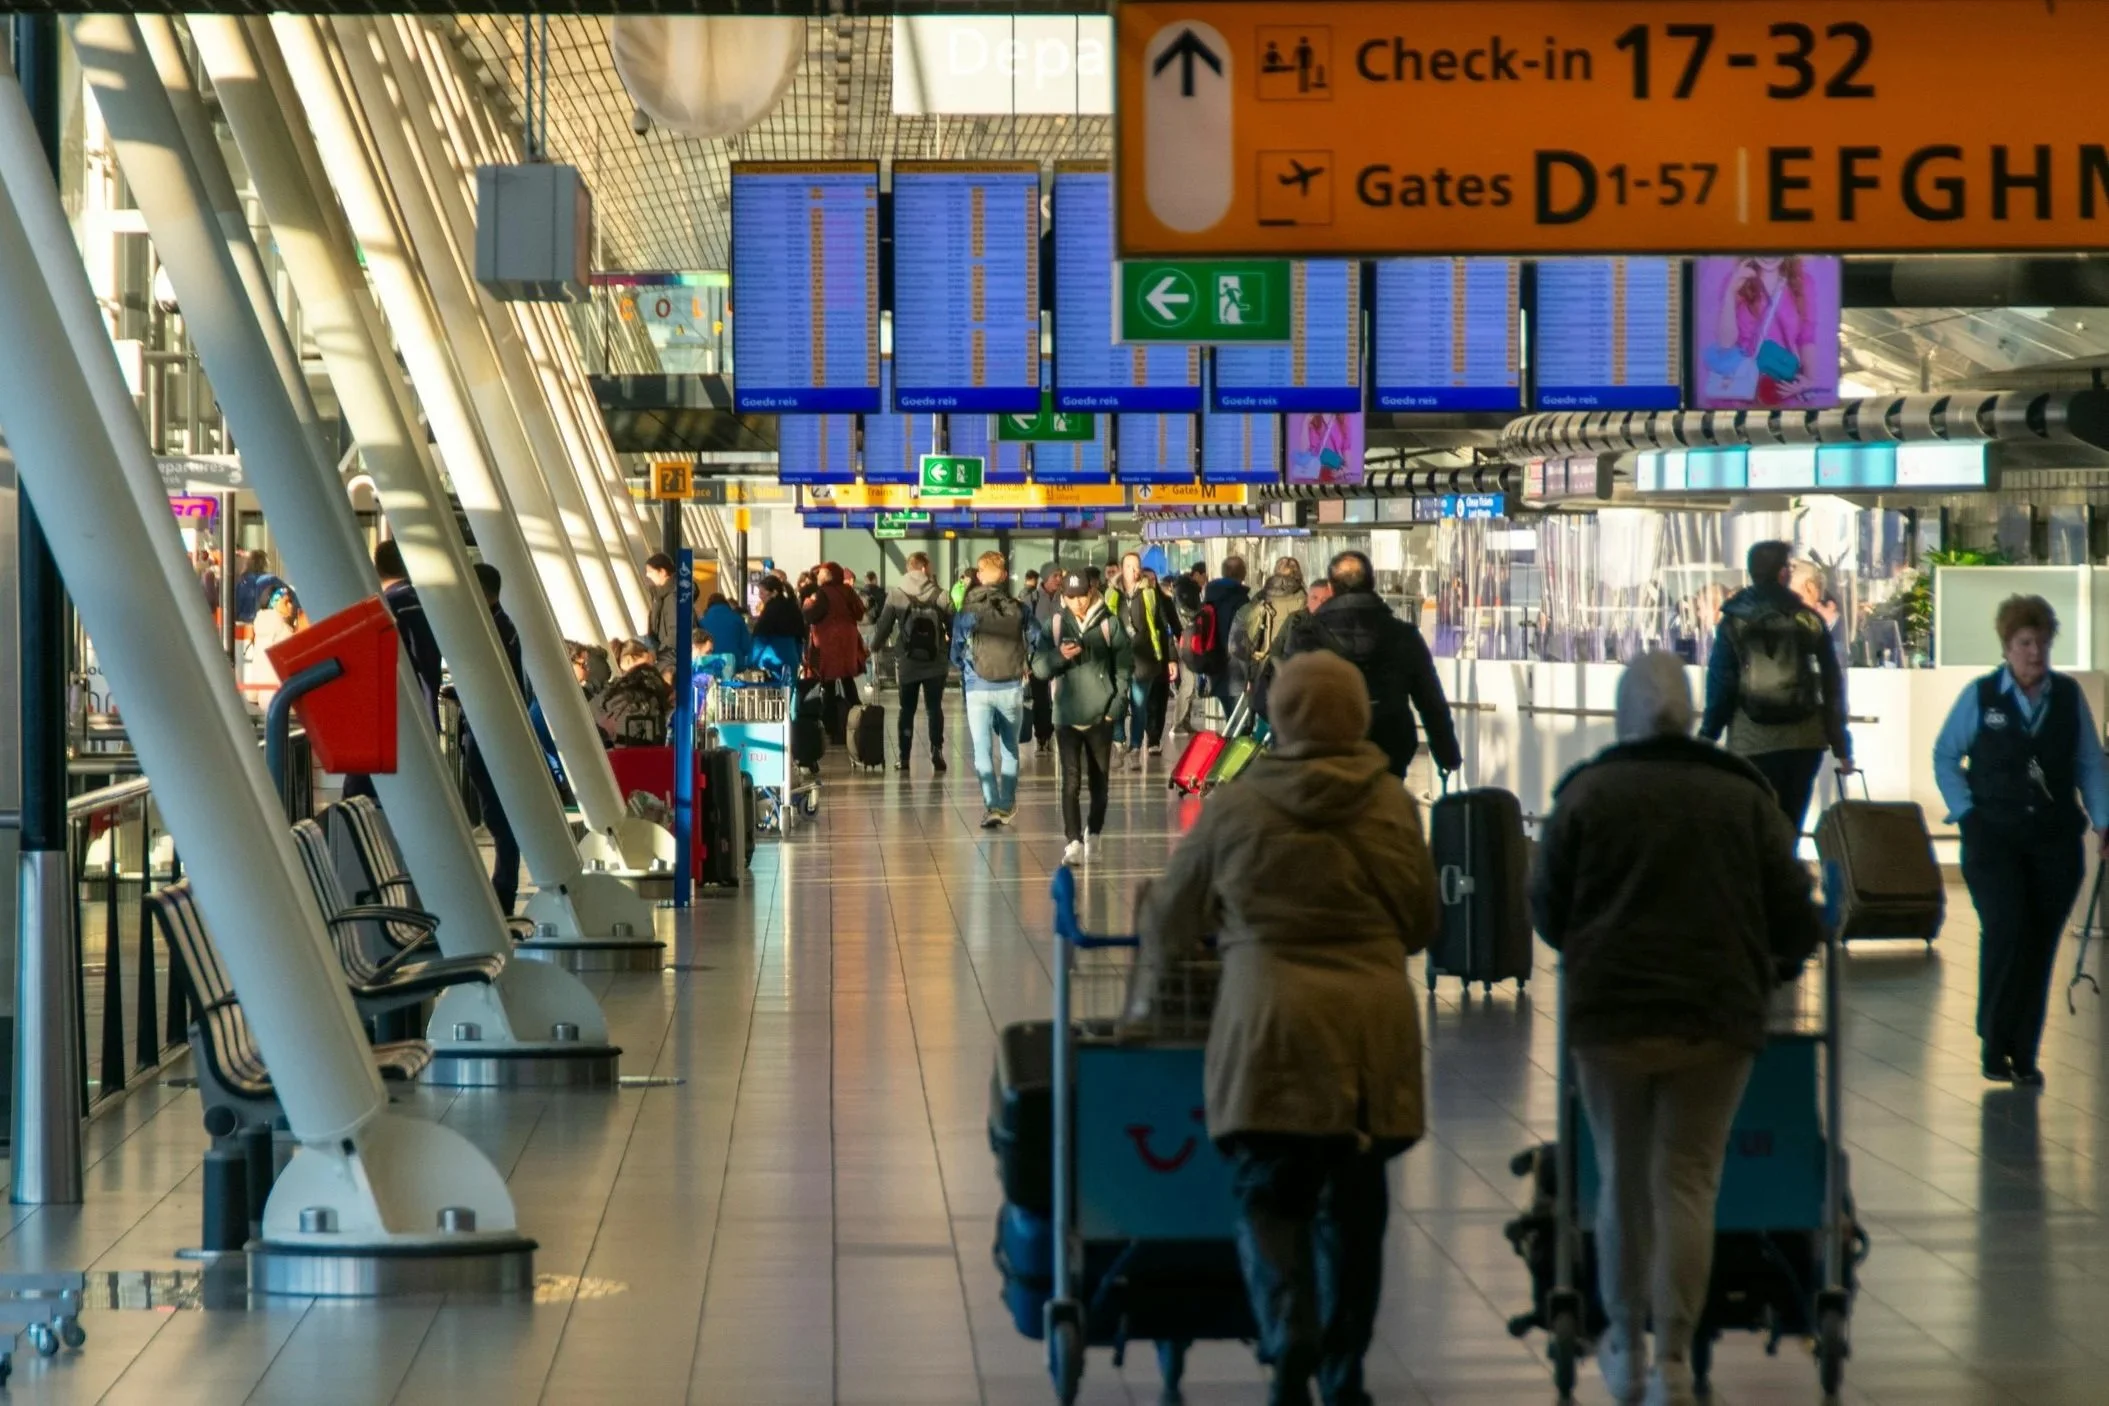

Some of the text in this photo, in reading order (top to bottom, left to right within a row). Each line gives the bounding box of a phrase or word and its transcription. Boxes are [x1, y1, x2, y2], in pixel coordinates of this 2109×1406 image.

[948, 28, 1105, 90] Depa
[1356, 22, 1876, 100] Check-in 17-32
[1356, 164, 1513, 208] Gates
[741, 397, 798, 407] Goede reis
[901, 396, 957, 406] Goede reis
[1063, 396, 1118, 406] Goede reis
[1222, 396, 1278, 406] Goede reis
[1381, 396, 1437, 406] Goede reis
[1542, 396, 1598, 405] Goede reis
[157, 462, 225, 475] epartures
[1173, 484, 1216, 499] Gates M
